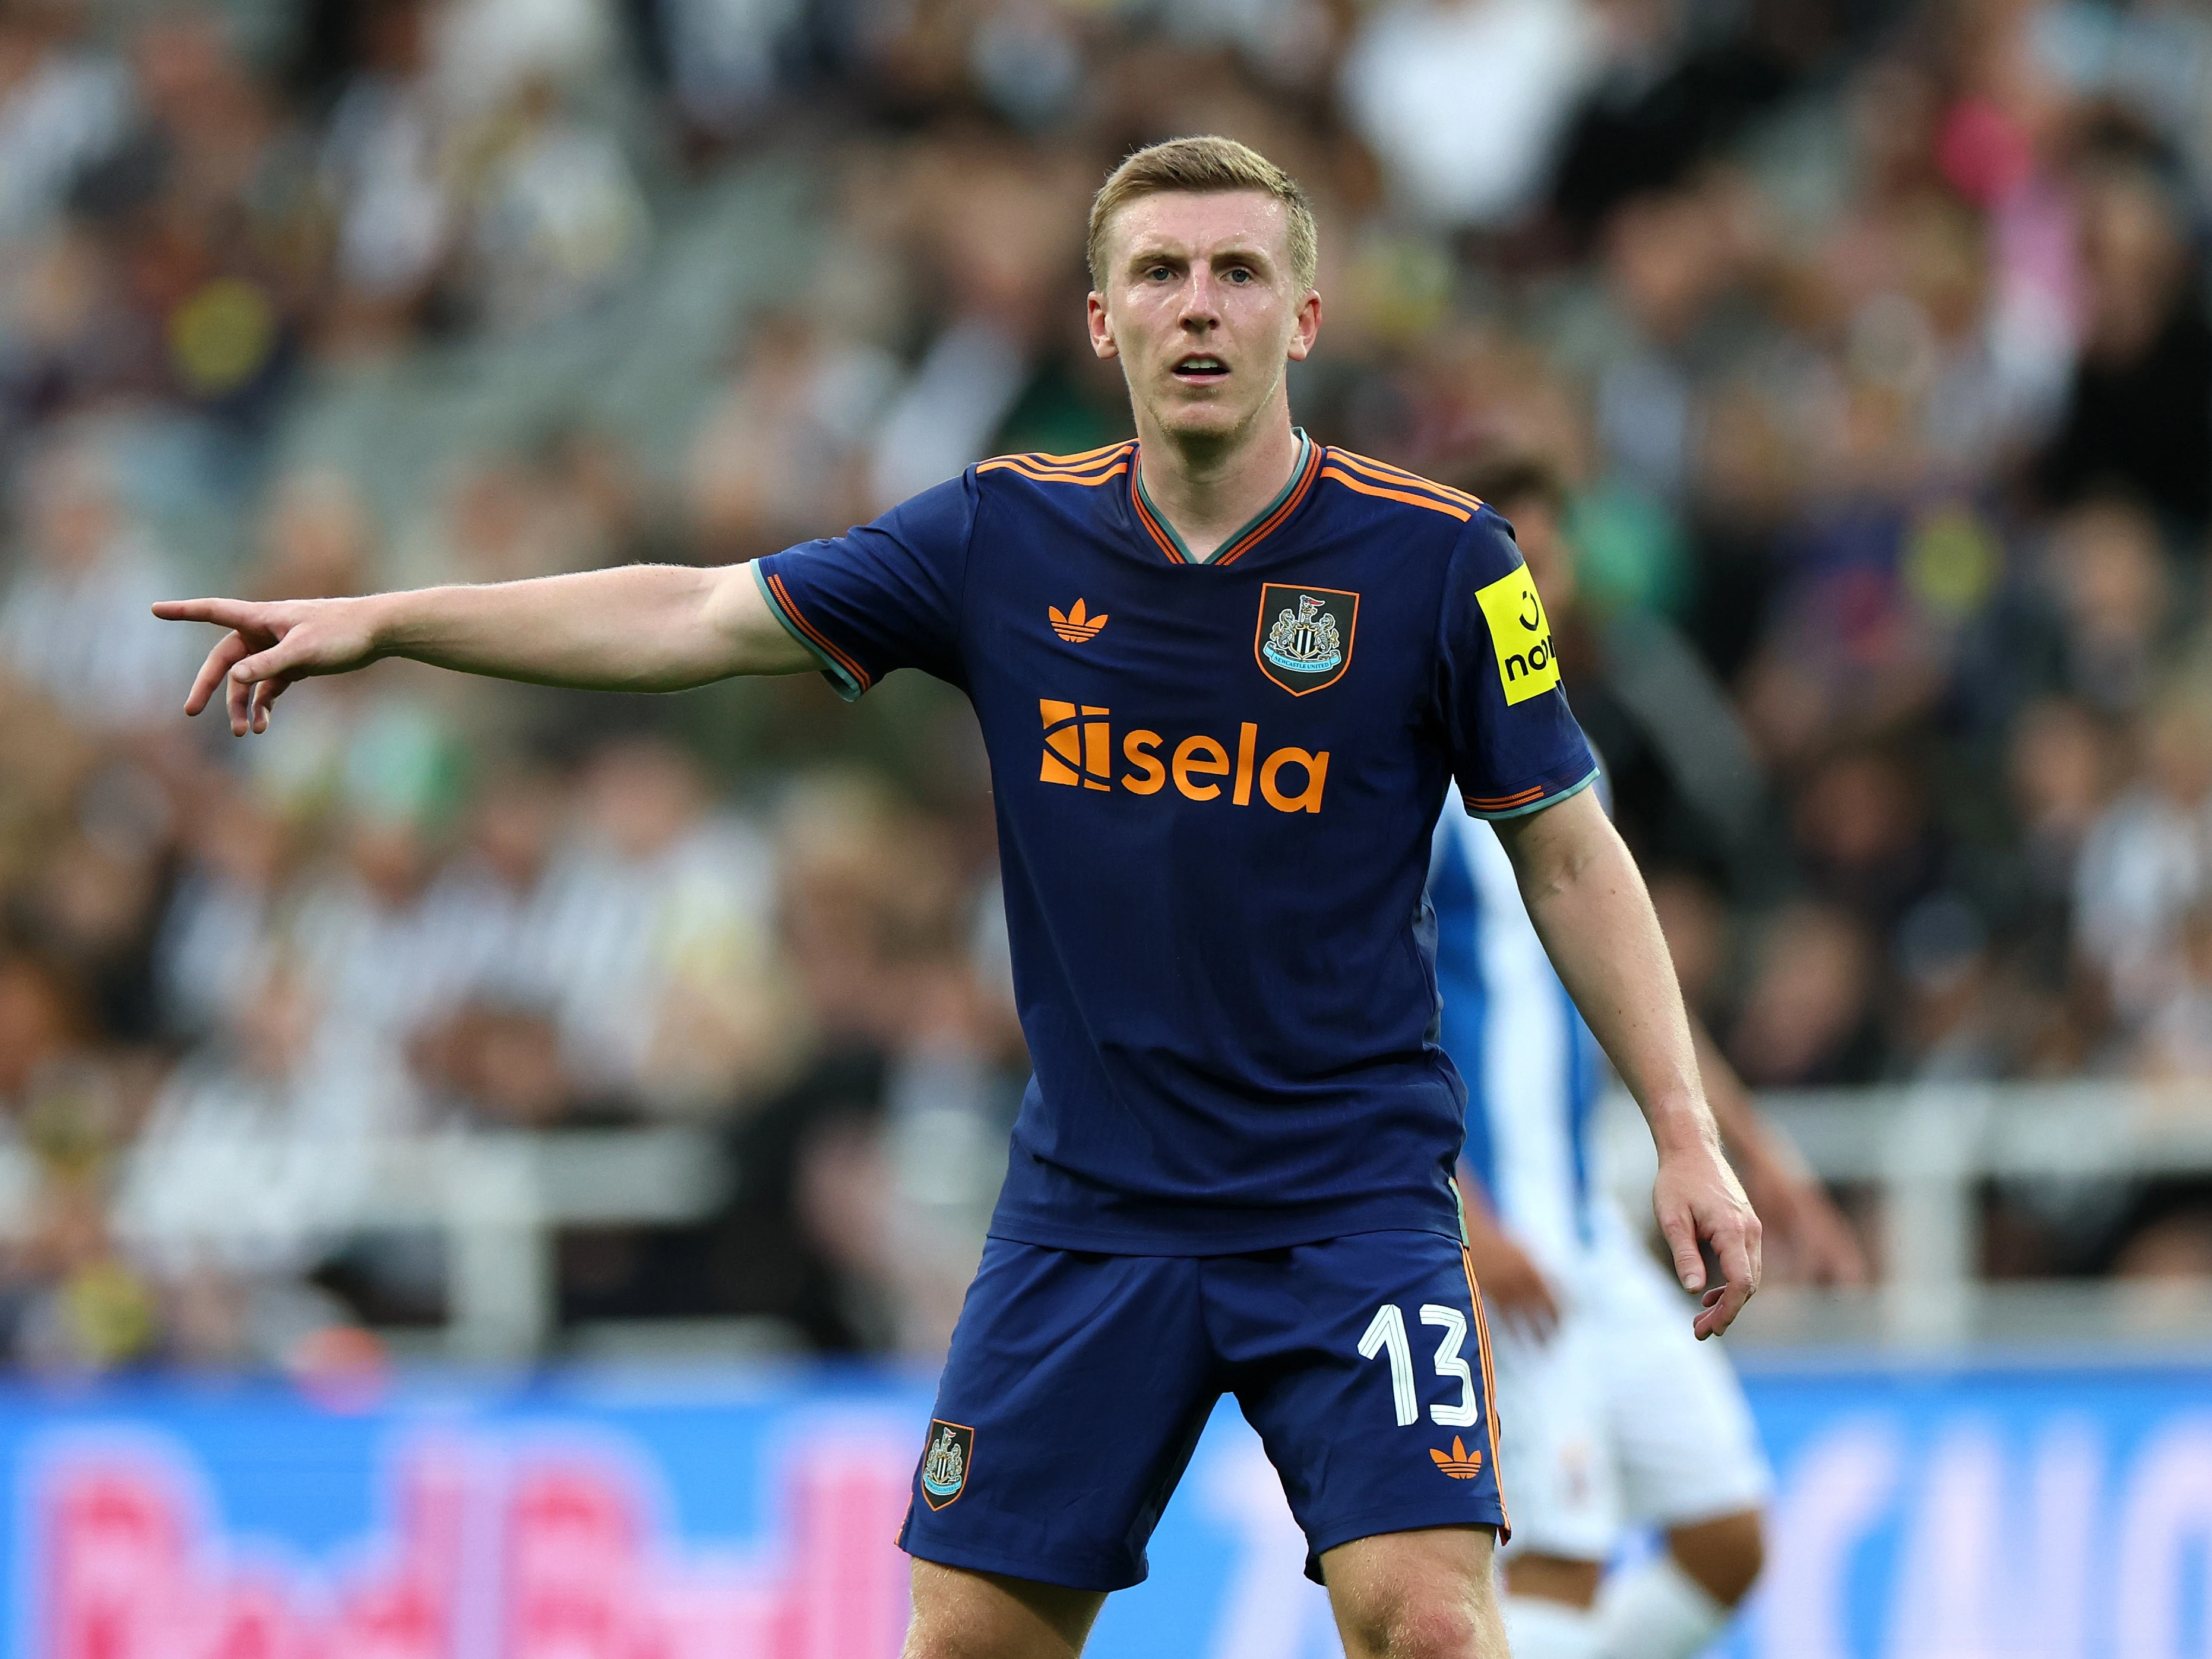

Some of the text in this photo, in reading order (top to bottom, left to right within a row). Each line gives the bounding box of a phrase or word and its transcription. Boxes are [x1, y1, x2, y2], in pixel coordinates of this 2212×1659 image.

[1274, 656, 1307, 669] NEWCASTLE
[1121, 721, 1330, 813] sela
[1357, 1304, 1478, 1427] 13
